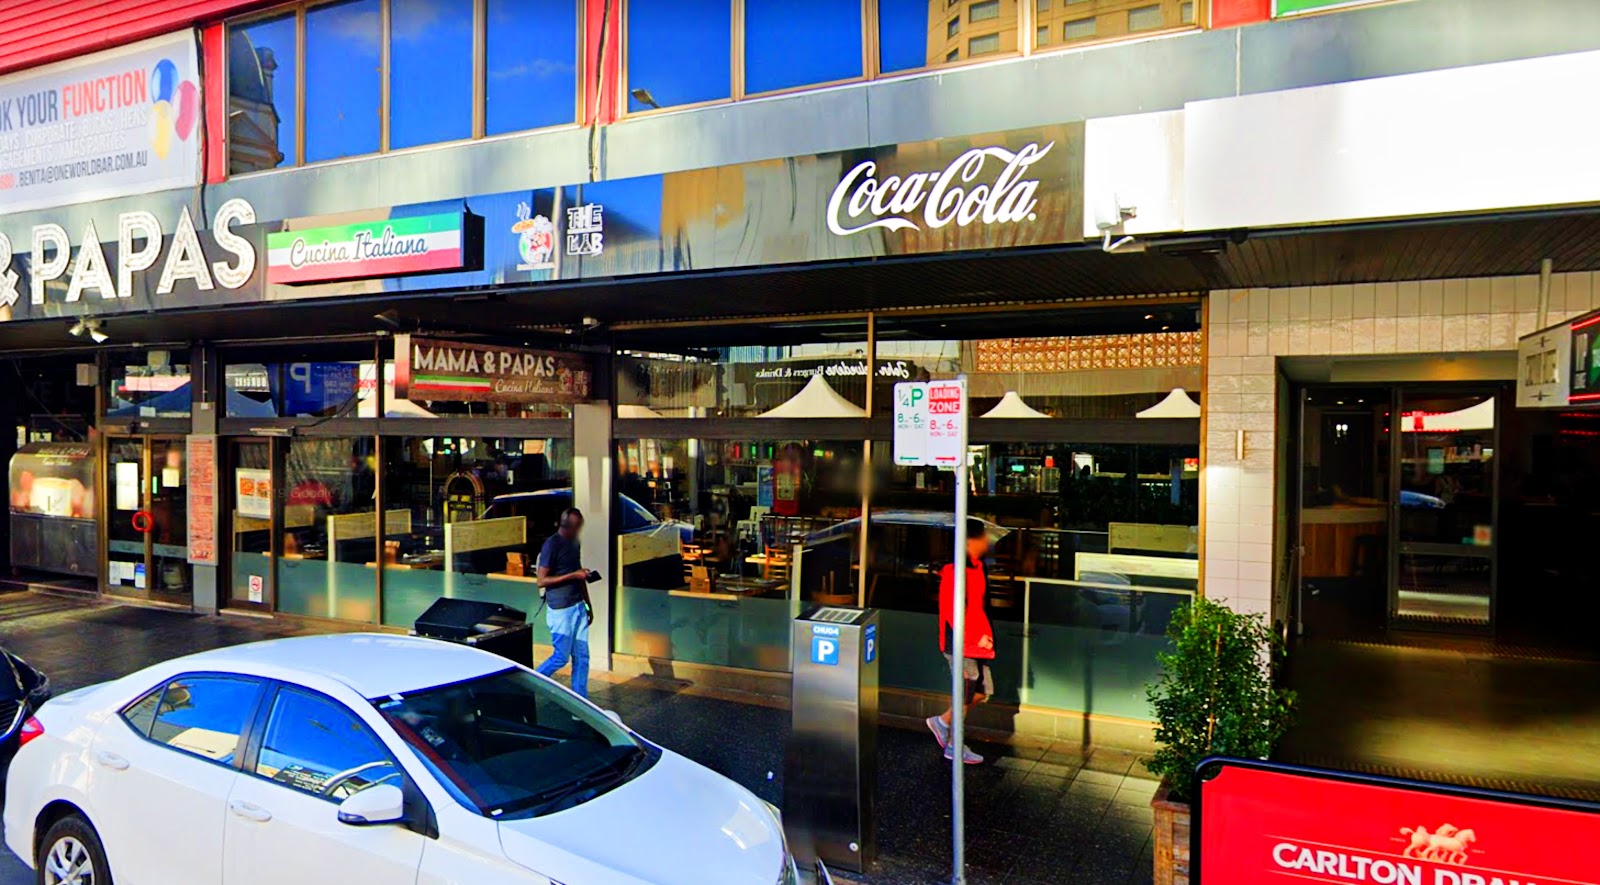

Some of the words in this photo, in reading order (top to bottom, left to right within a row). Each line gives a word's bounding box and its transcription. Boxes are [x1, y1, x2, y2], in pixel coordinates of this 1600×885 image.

[16, 89, 58, 128] YOUR
[63, 69, 147, 120] FUNCTION
[567, 203, 603, 230] THE
[31, 198, 256, 305] PAPAS
[290, 239, 347, 269] Cucina
[353, 225, 428, 260] Italiana
[414, 344, 480, 374] MAMA
[483, 351, 496, 374] &
[500, 351, 556, 377] PAPAS
[494, 378, 523, 394] Cucina
[930, 388, 960, 399] LOADING
[929, 401, 960, 413] ZONE
[818, 640, 835, 662] P
[1272, 843, 1422, 885] CARLTON
